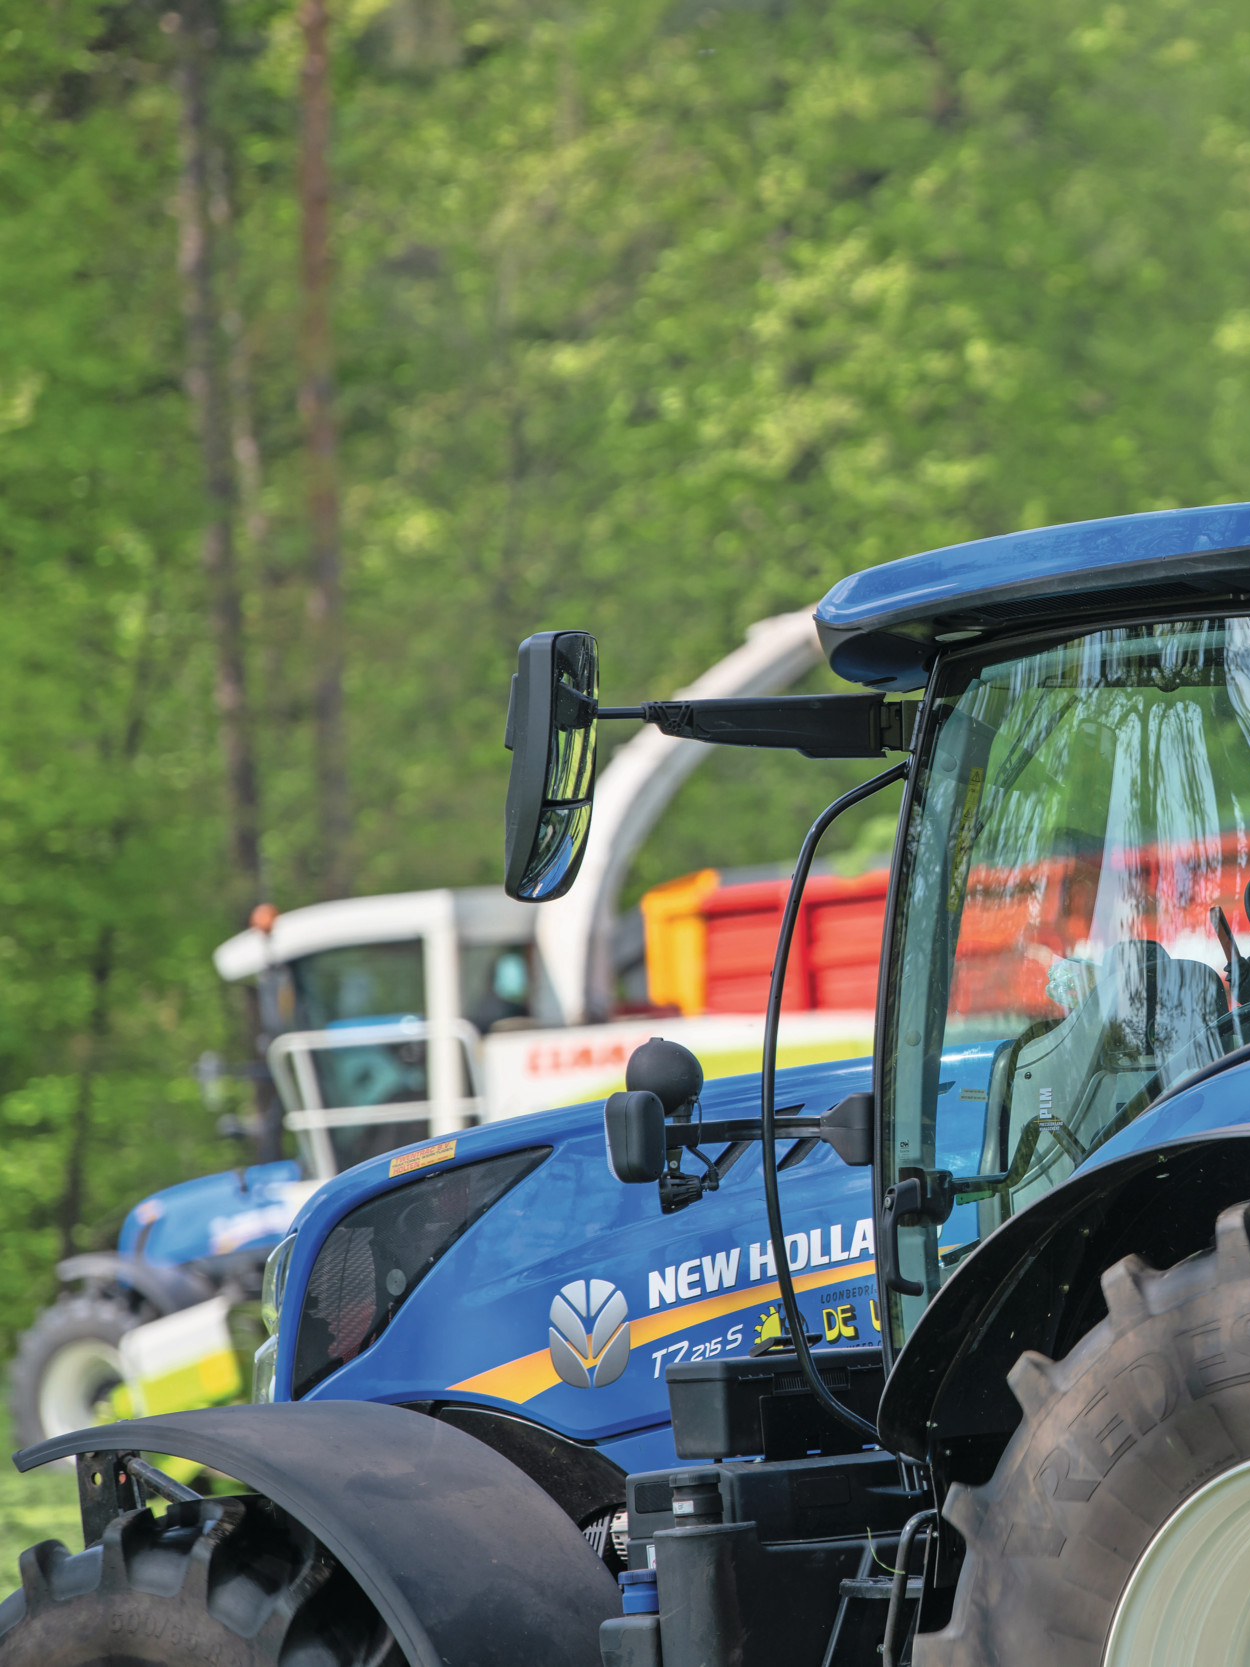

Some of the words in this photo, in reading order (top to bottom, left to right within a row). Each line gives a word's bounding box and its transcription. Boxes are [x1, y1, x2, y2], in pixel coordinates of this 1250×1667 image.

[527, 1043, 632, 1077] CLAA
[1039, 1087, 1052, 1119] PLM
[393, 1161, 420, 1175] HOLTEN
[395, 1146, 435, 1163] TWENTRAC
[648, 1247, 741, 1309] NEW
[749, 1217, 875, 1281] HOLLA
[820, 1284, 878, 1304] LOONBEDRI
[822, 1303, 859, 1345] DE
[652, 1340, 690, 1379] T7
[690, 1336, 723, 1362] 215
[726, 1323, 744, 1352] S
